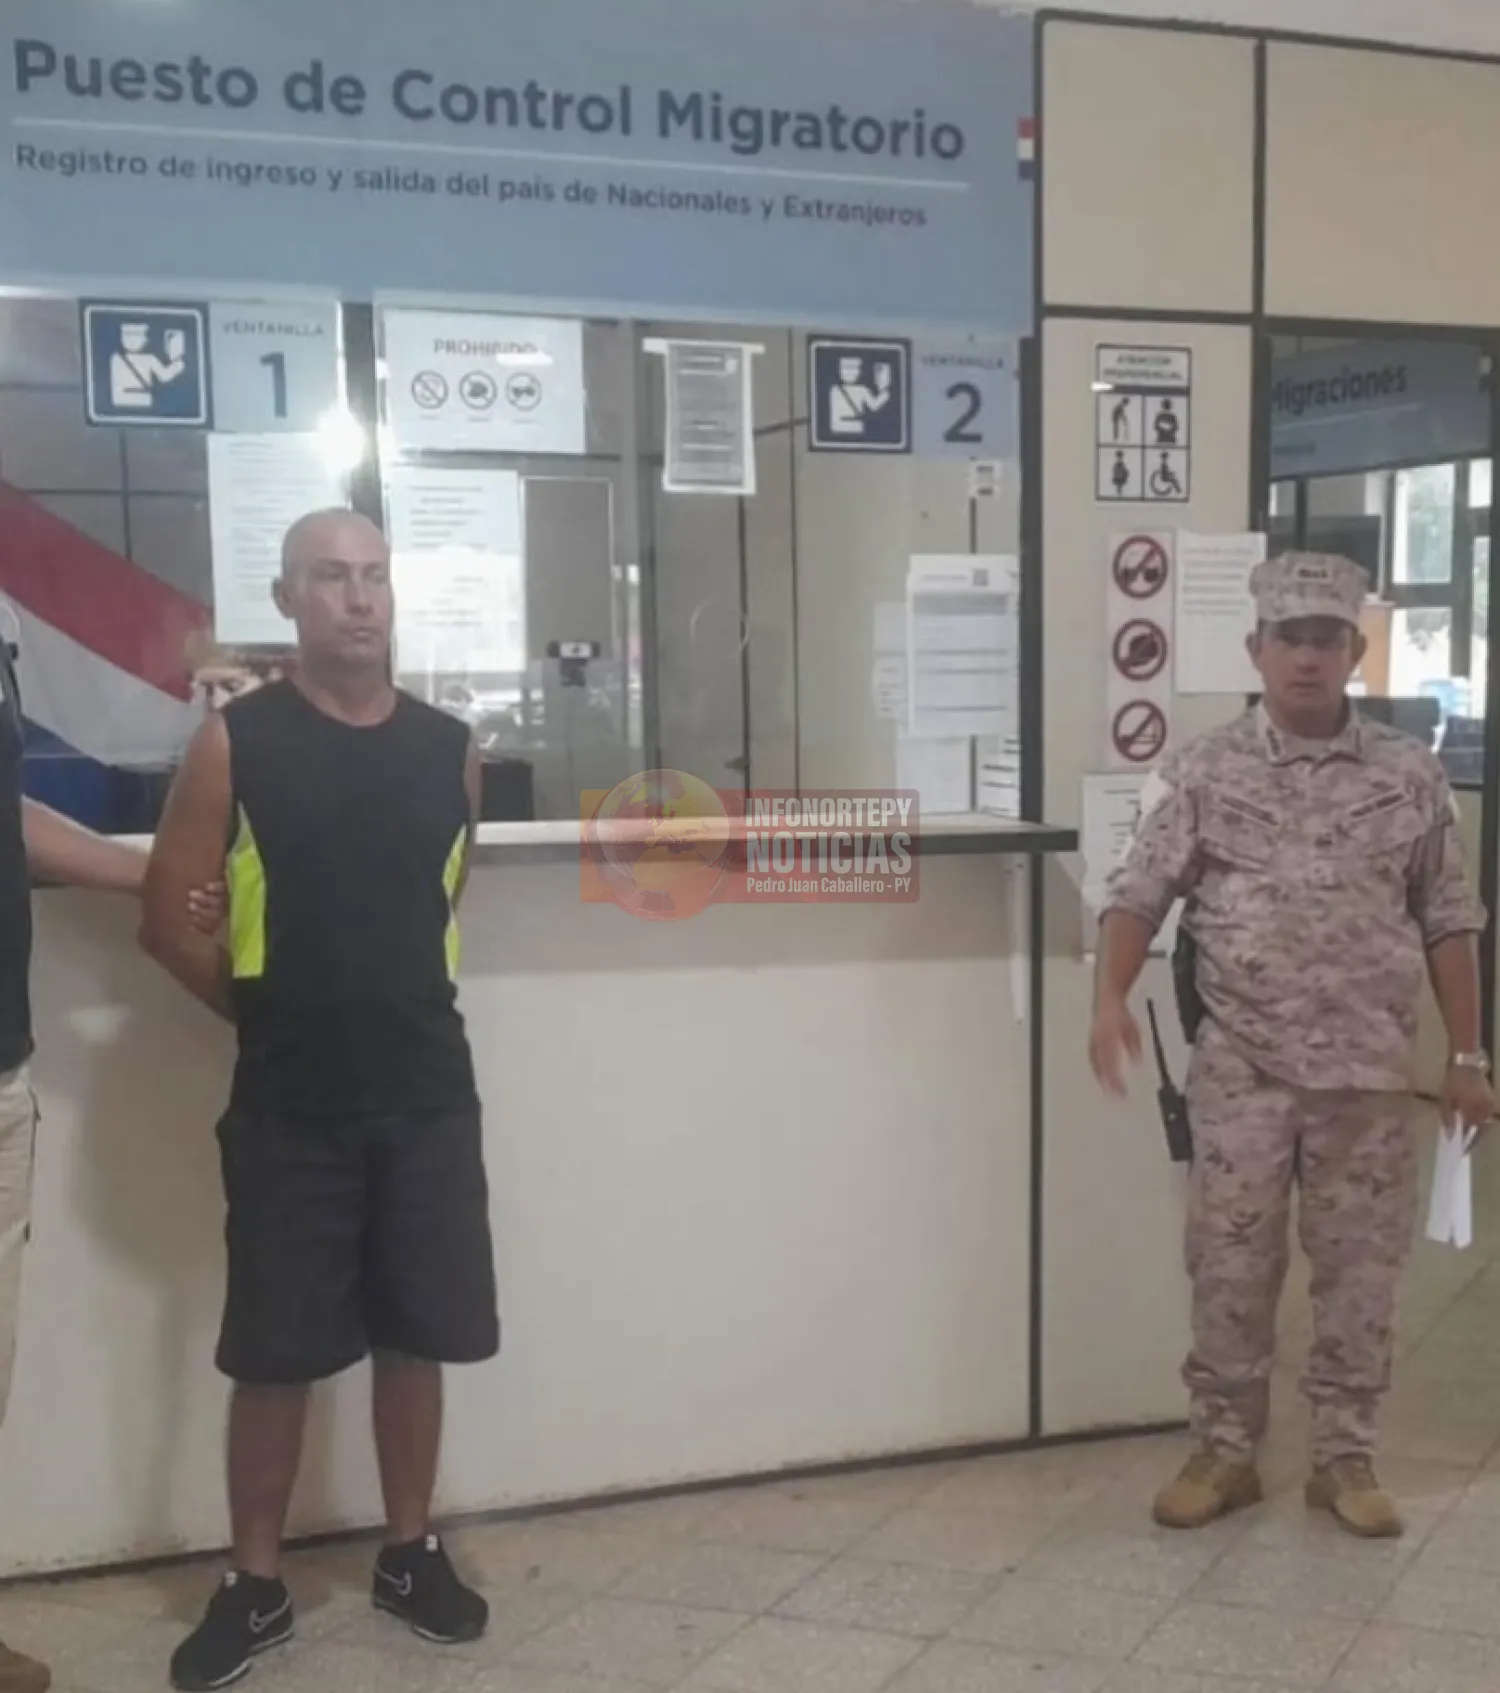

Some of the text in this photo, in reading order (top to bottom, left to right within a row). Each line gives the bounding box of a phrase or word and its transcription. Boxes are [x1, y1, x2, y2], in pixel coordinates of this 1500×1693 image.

[13, 38, 965, 160] Puesto de Control Migratorio
[16, 143, 148, 176] Registro
[158, 154, 196, 178] de
[206, 157, 317, 187] ingreso
[327, 168, 343, 191] y
[354, 167, 435, 194] salida
[446, 173, 489, 197] del
[563, 179, 599, 203] de
[607, 183, 751, 215] Nacionales
[760, 199, 774, 220] y
[783, 195, 927, 227] Extranjeros
[259, 352, 287, 418] 1
[943, 381, 983, 443] 2
